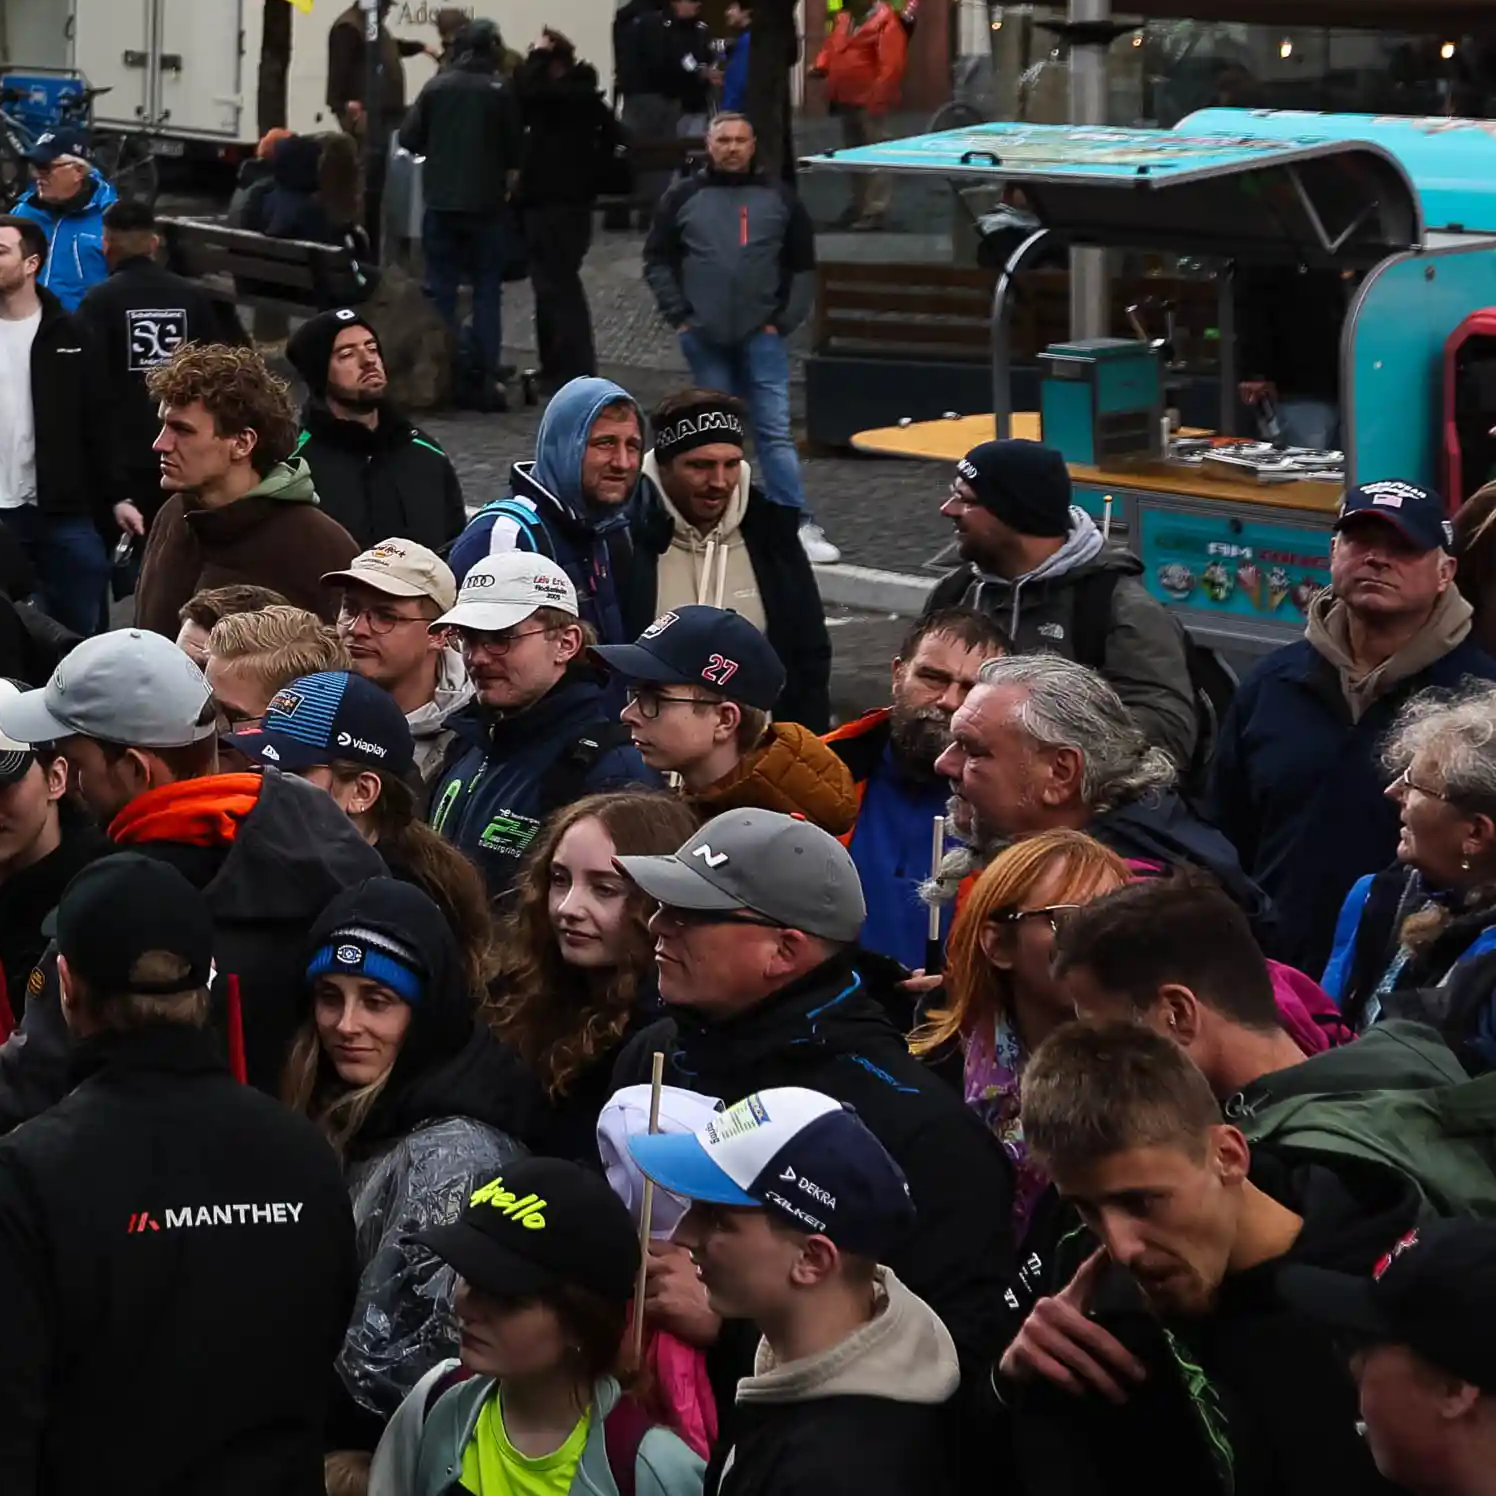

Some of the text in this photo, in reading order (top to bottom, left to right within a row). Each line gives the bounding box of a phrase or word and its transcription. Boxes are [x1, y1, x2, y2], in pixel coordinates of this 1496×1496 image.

[701, 653, 739, 686] 27
[353, 737, 388, 758] viaplay
[798, 1176, 837, 1210] DEKRA
[165, 1202, 305, 1229] MANTHEY
[766, 1190, 826, 1232] FALKEN
